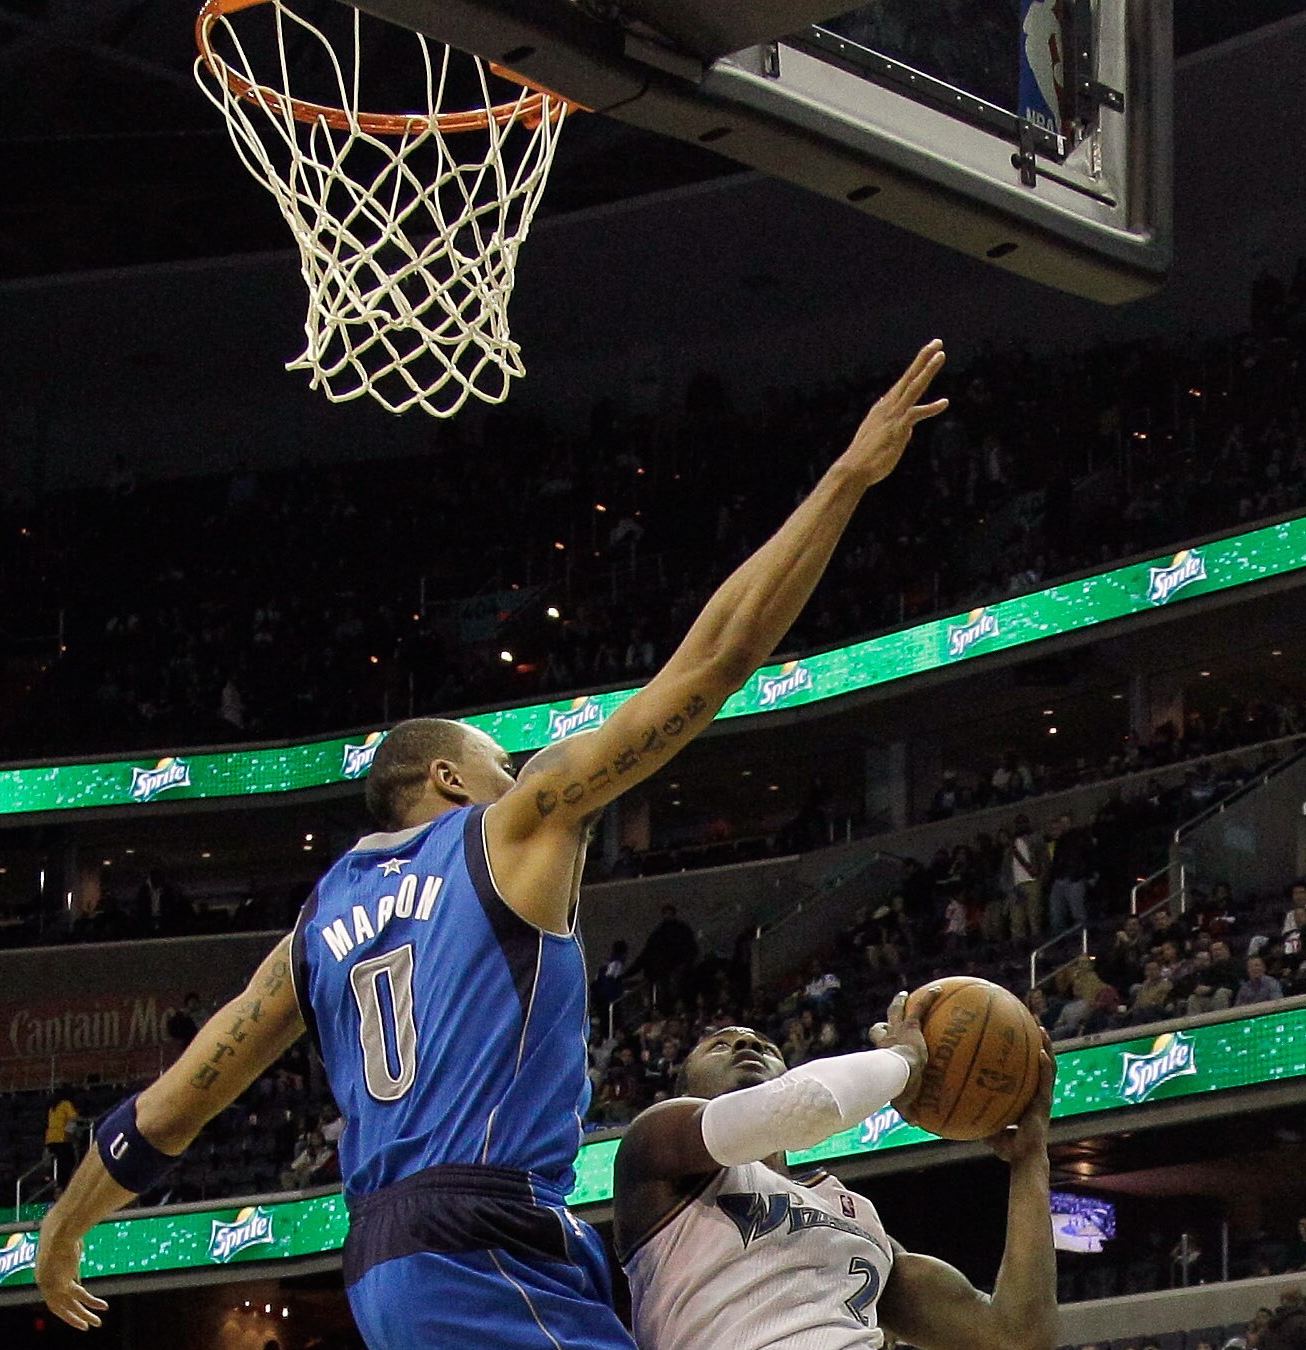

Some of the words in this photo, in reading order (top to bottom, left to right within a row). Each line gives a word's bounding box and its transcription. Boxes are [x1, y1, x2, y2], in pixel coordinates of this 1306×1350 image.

[1149, 557, 1200, 601] Sprite
[949, 613, 993, 656] Sprite
[760, 667, 808, 705] Sprite
[551, 702, 599, 740] Sprite
[133, 763, 186, 798] Sprite
[345, 747, 376, 774] Spr
[350, 944, 417, 1101] 0
[1125, 1041, 1186, 1095] Sprite
[211, 1215, 267, 1258] Sprite
[844, 1256, 880, 1328] 2
